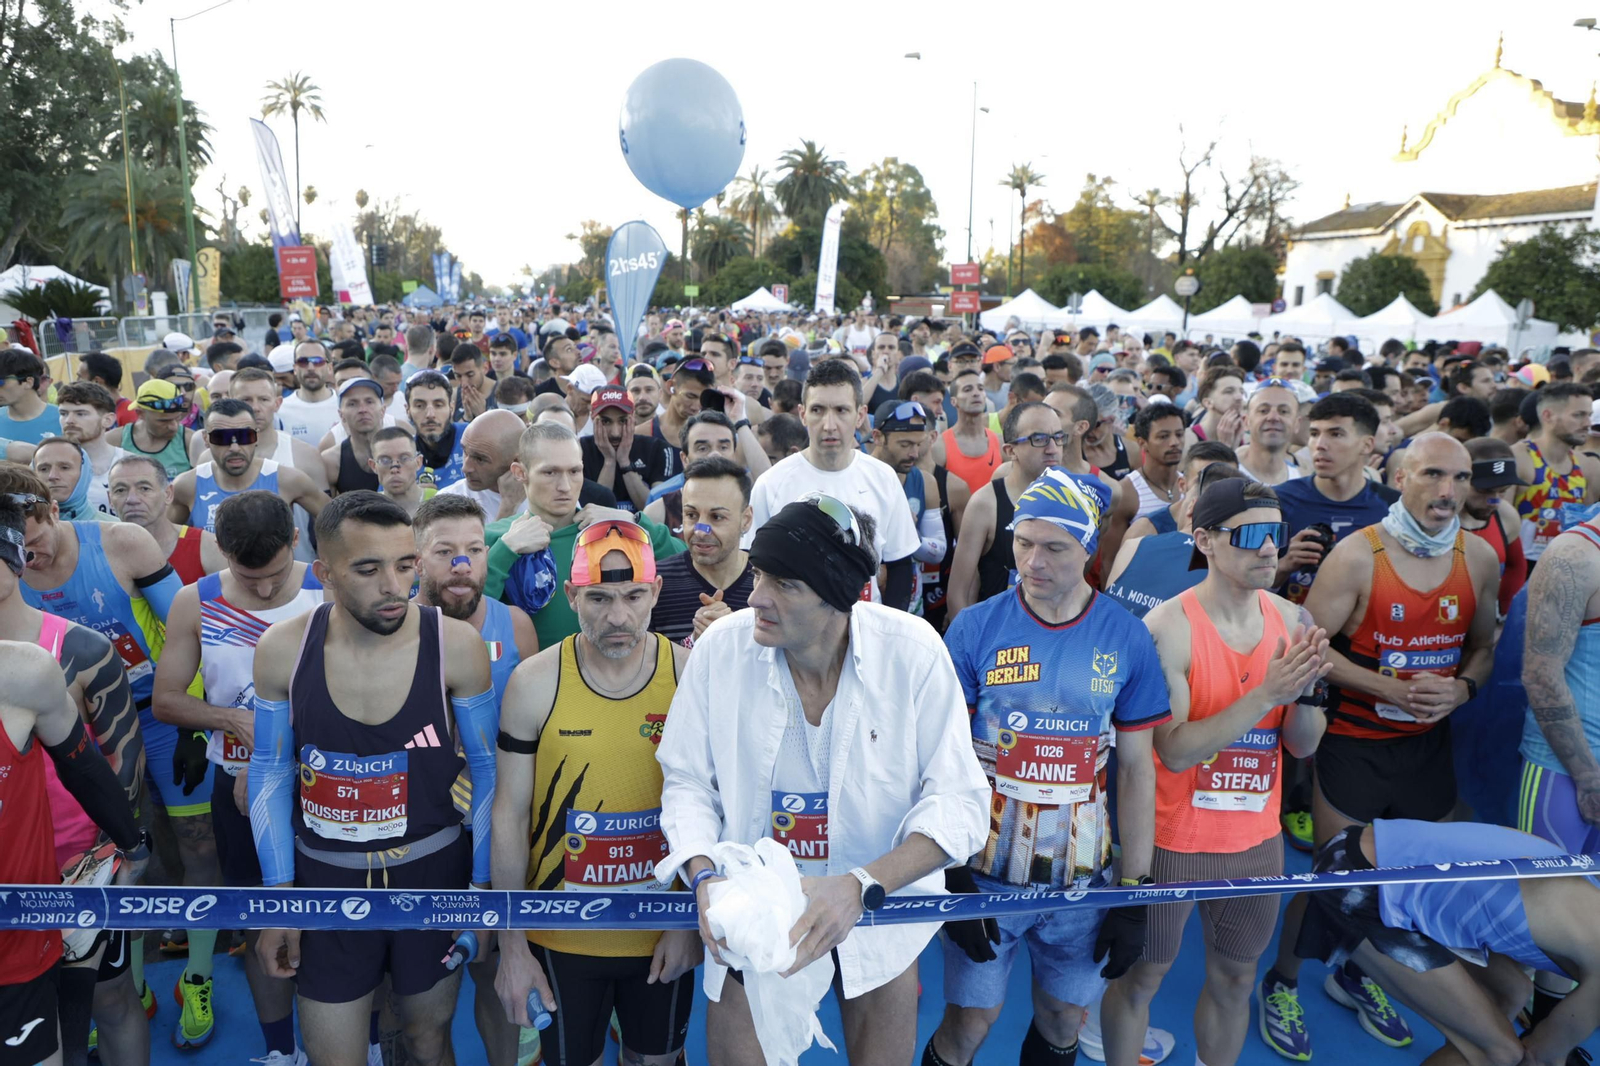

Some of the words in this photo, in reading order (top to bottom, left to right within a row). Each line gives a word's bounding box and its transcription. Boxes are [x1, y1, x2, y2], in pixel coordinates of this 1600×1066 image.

[996, 645, 1030, 667] RUN
[1411, 654, 1454, 665] ZURICH
[985, 663, 1041, 686] BERLIN
[1091, 678, 1115, 693] OTSO
[1034, 718, 1089, 731] ZURICH
[1236, 733, 1276, 745] URICH
[1034, 744, 1064, 757] 1026
[332, 759, 393, 774] ZURICH
[1232, 757, 1259, 769] 1168
[1015, 761, 1077, 782] JANNE
[1211, 772, 1270, 791] STEFAN
[337, 786, 359, 800] 571
[301, 797, 359, 822] YOUSSEF
[363, 804, 406, 822] IZIKKI
[604, 815, 660, 831] ZURICH
[609, 845, 633, 858] 913
[1532, 859, 1568, 869] SEVILLA
[582, 860, 655, 883] AITANA
[18, 891, 73, 899] SEVILLA
[21, 899, 75, 908] MARATÓN
[119, 896, 185, 914] asics
[249, 899, 337, 914] ZURICH
[432, 901, 480, 910] MARATÓN
[519, 899, 580, 914] asics
[21, 912, 75, 924] ZURICH
[432, 912, 480, 923] ZURICH
